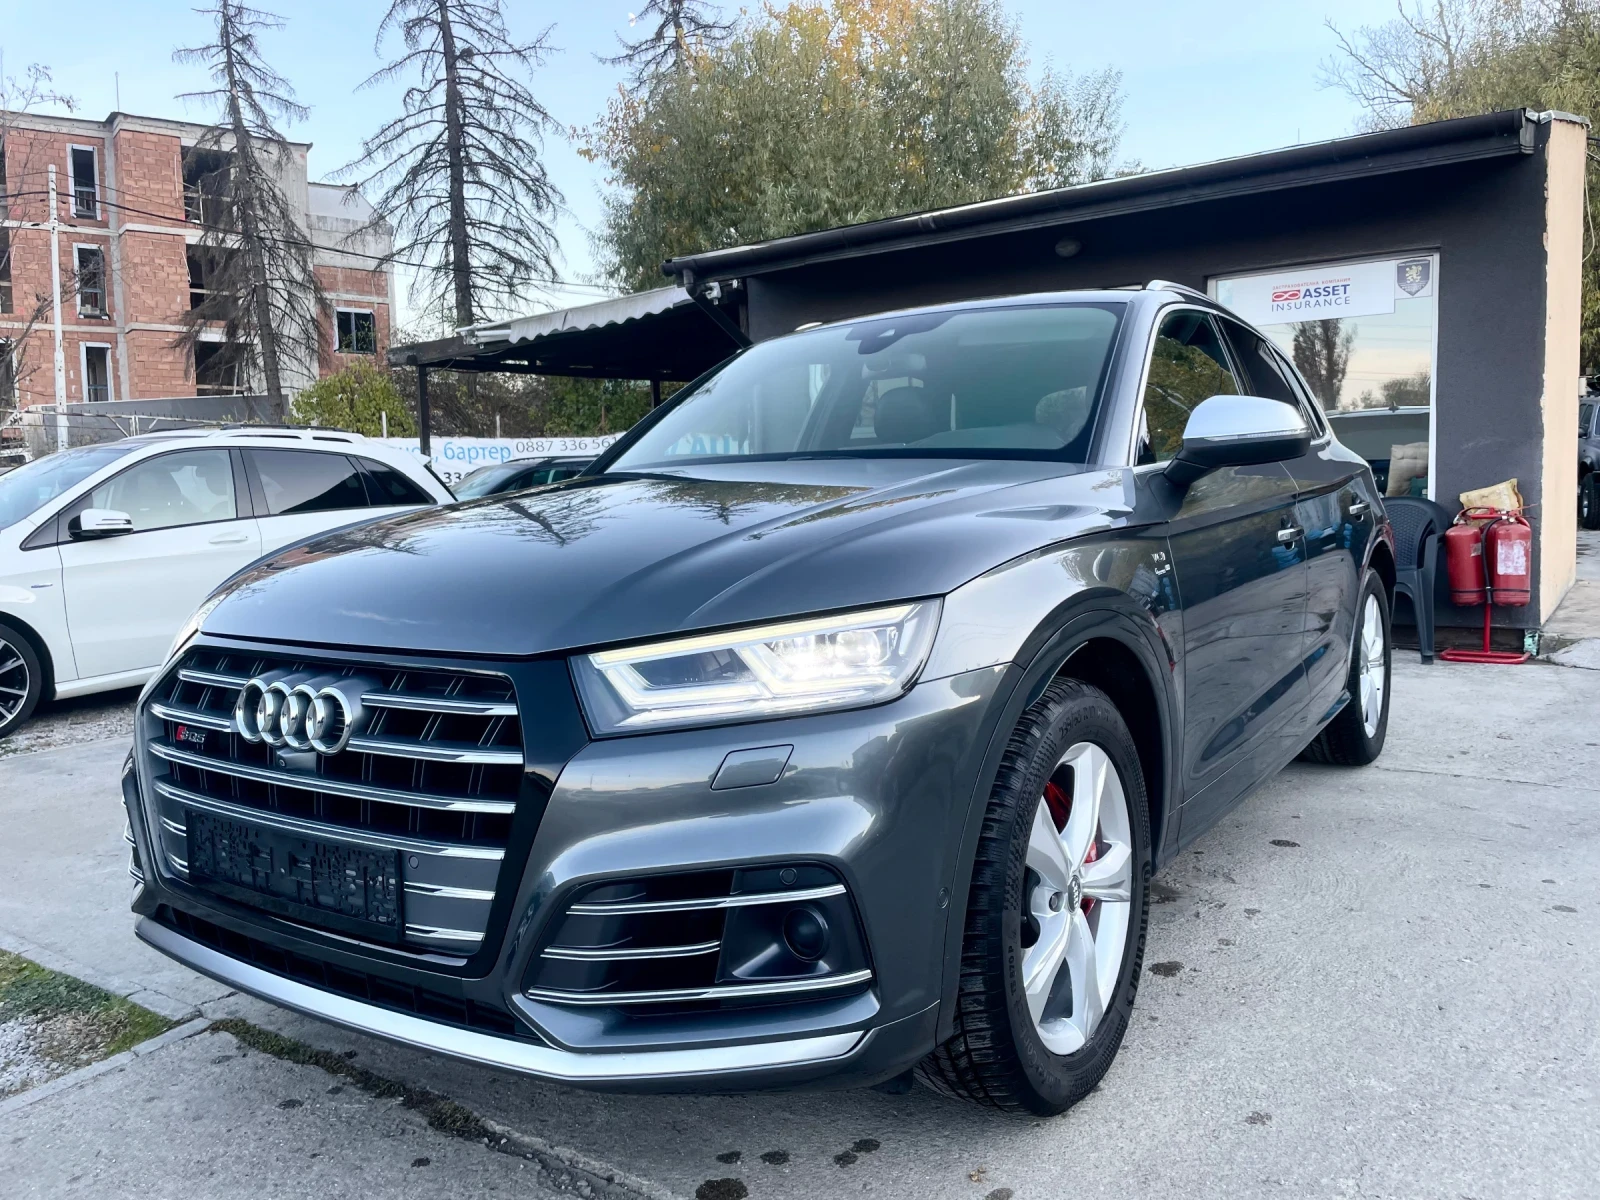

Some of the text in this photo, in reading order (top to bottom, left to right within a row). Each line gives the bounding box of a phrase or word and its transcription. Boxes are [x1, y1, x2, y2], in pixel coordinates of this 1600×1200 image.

[1302, 283, 1351, 300] ASSET
[1271, 296, 1351, 312] INSURANCE
[443, 441, 511, 464] бартер
[515, 440, 554, 454] 0887
[560, 439, 588, 452] 336
